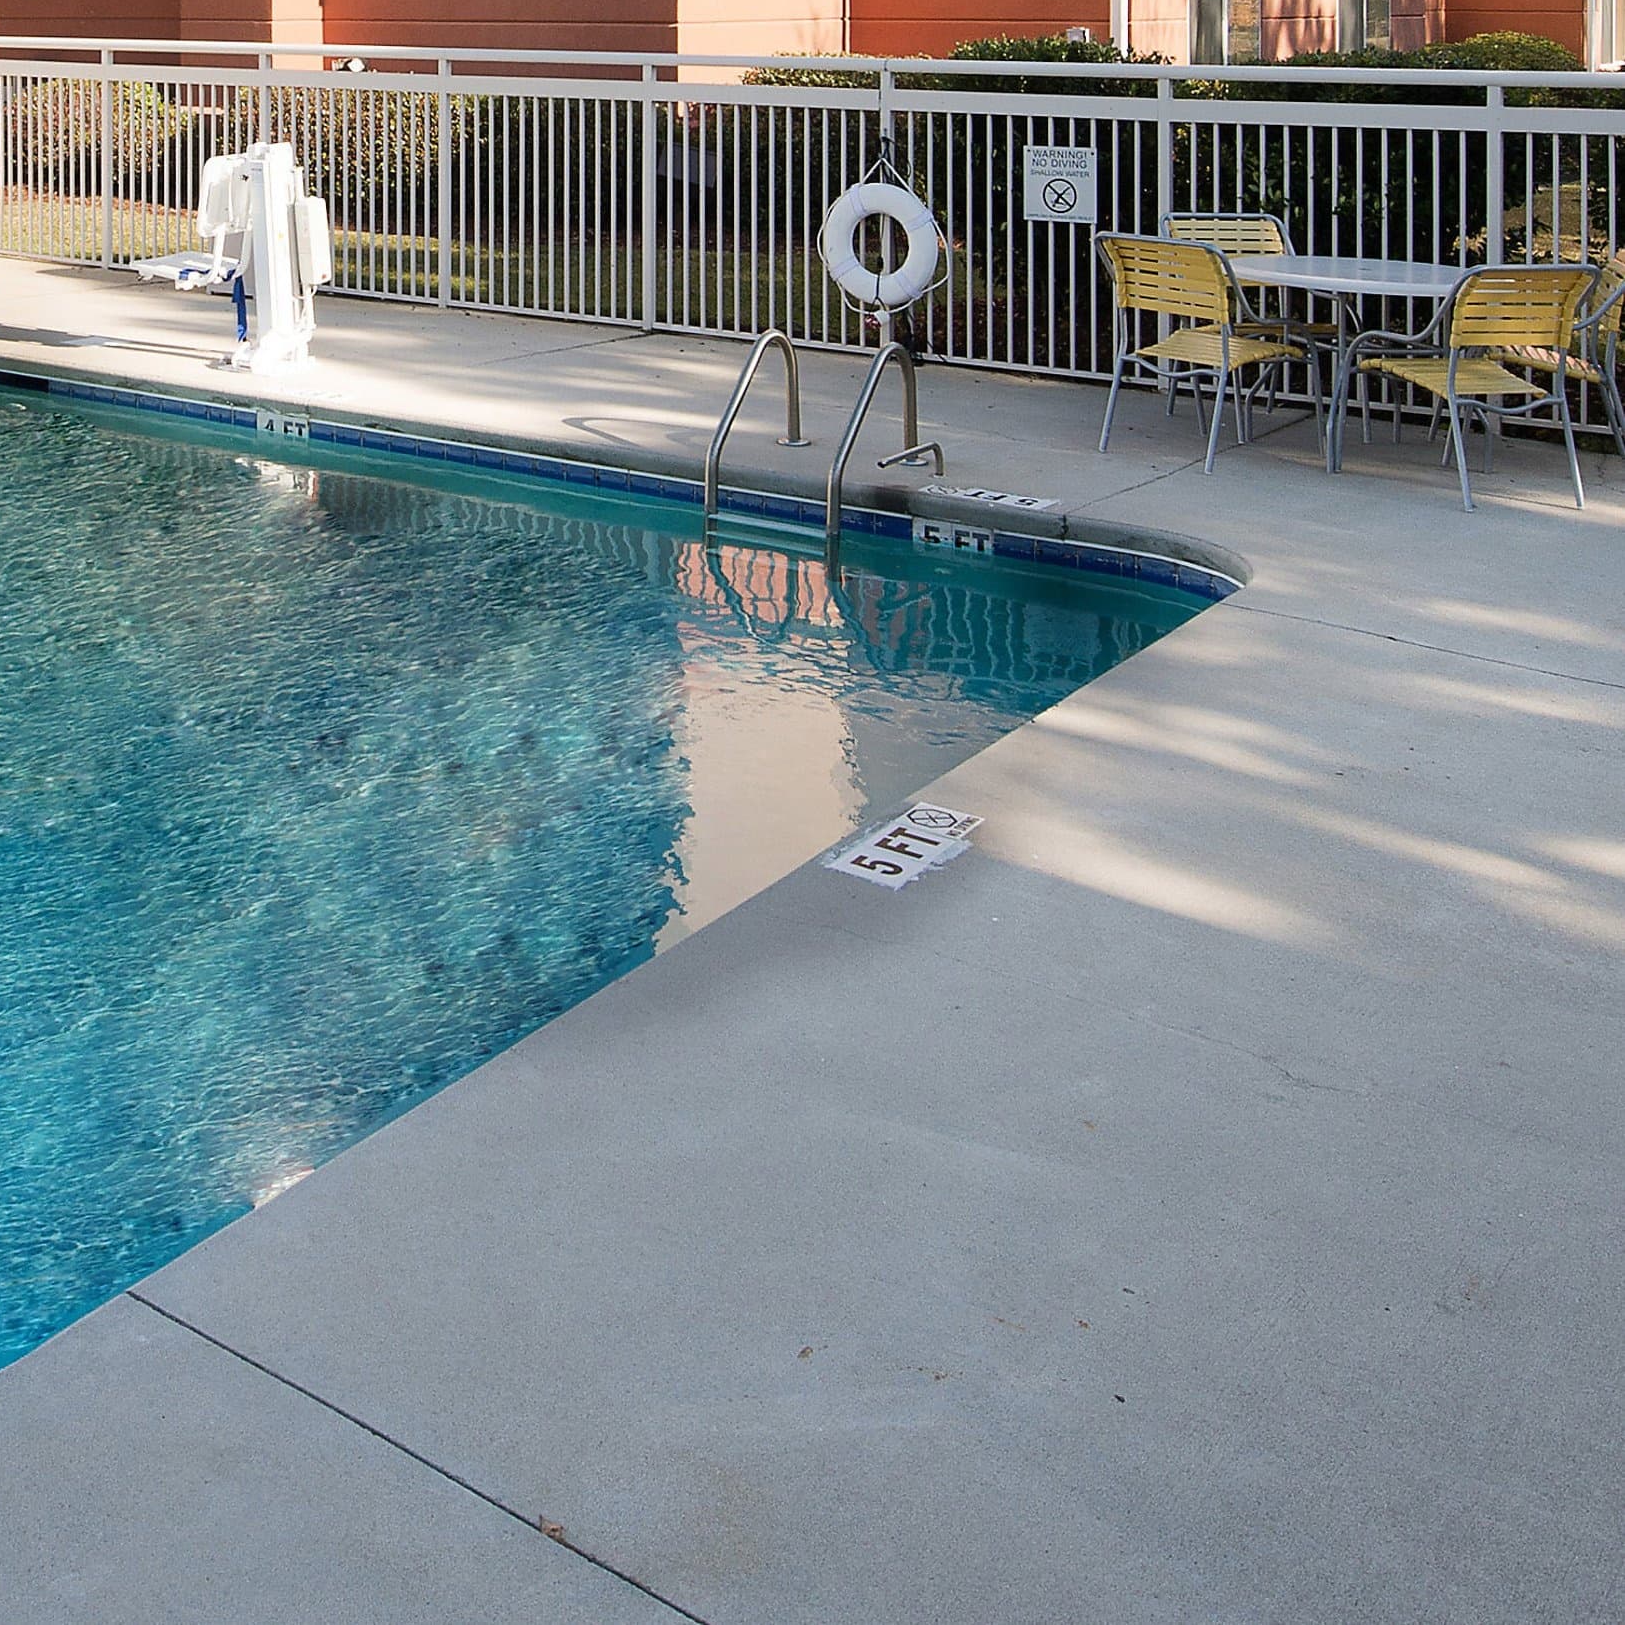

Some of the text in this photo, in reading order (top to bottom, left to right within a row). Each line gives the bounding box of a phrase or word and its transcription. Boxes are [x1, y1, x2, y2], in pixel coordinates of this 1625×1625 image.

[1032, 149, 1087, 160] WARNING!
[1032, 159, 1087, 169] NO DIVING
[954, 529, 991, 552] FT
[850, 826, 941, 876] 5 FT
